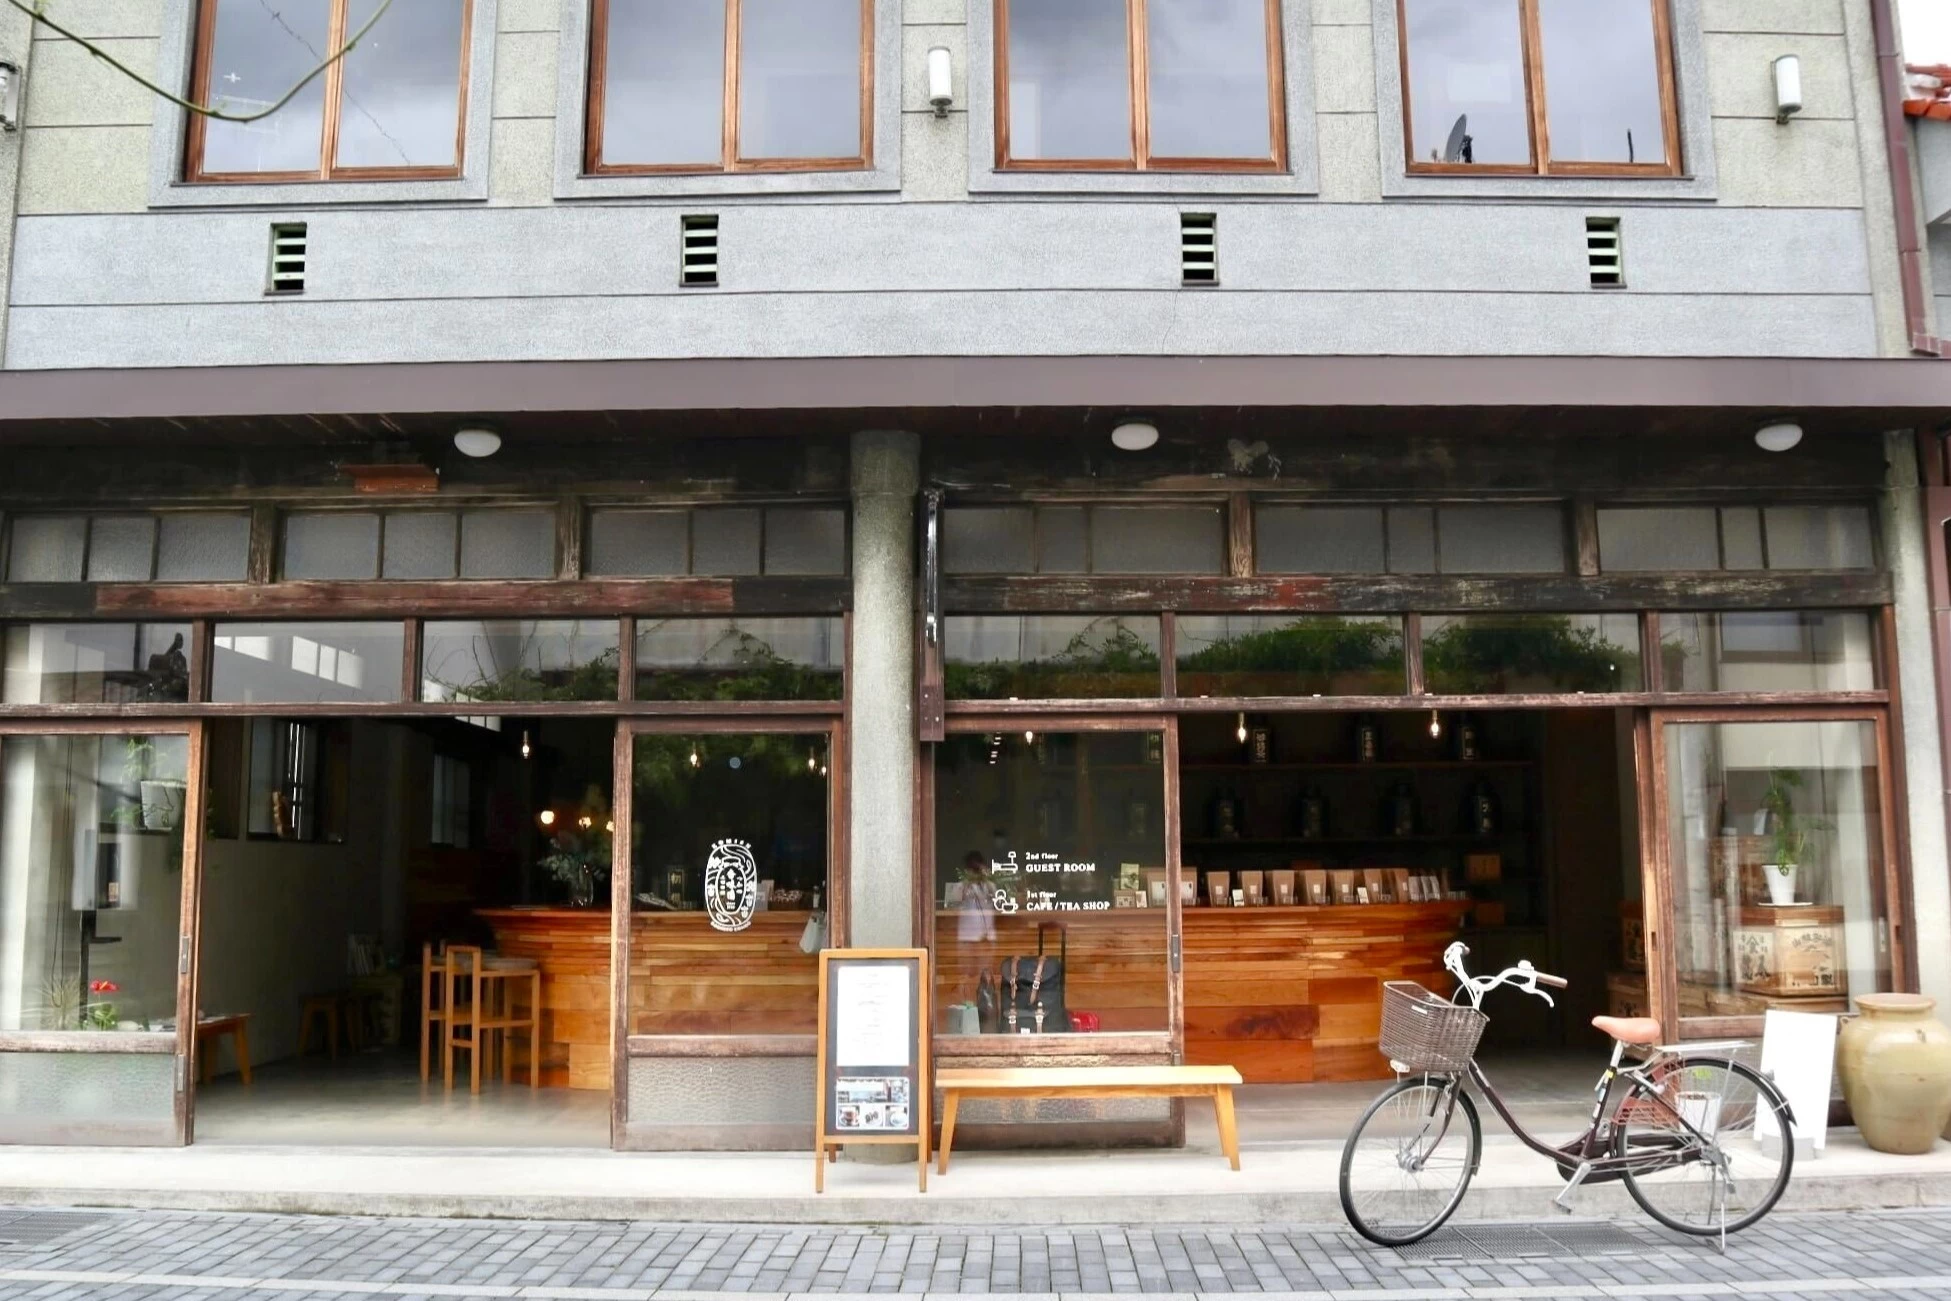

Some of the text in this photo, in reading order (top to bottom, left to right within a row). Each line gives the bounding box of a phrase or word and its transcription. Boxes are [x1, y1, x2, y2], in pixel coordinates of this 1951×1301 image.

[1025, 852, 1039, 860] 2nd
[1025, 863, 1096, 872] GUEST ROOM
[1026, 890, 1038, 899] 1st
[1060, 902, 1081, 911] TEA
[1083, 901, 1111, 910] SHOP
